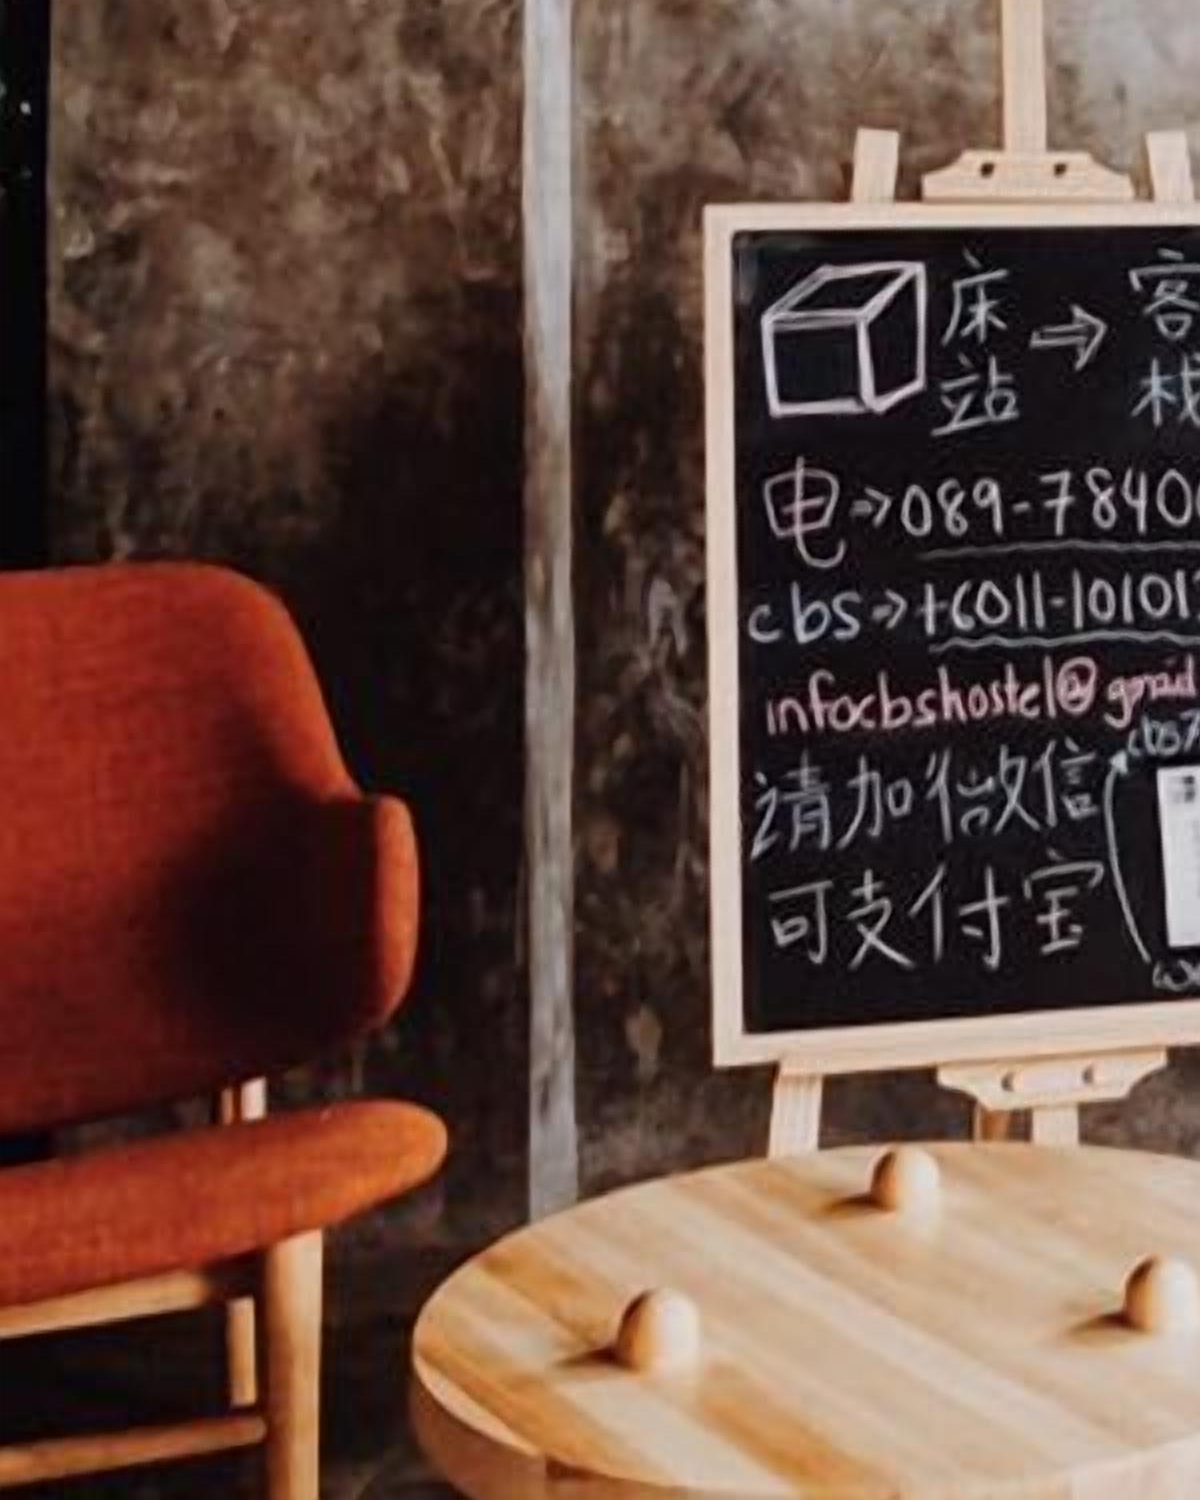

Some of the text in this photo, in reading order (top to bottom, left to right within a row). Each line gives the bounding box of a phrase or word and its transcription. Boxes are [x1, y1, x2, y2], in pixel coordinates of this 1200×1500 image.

[763, 457, 846, 568] 电
[747, 581, 861, 645] cbs
[767, 849, 1105, 971] 可支付宝
